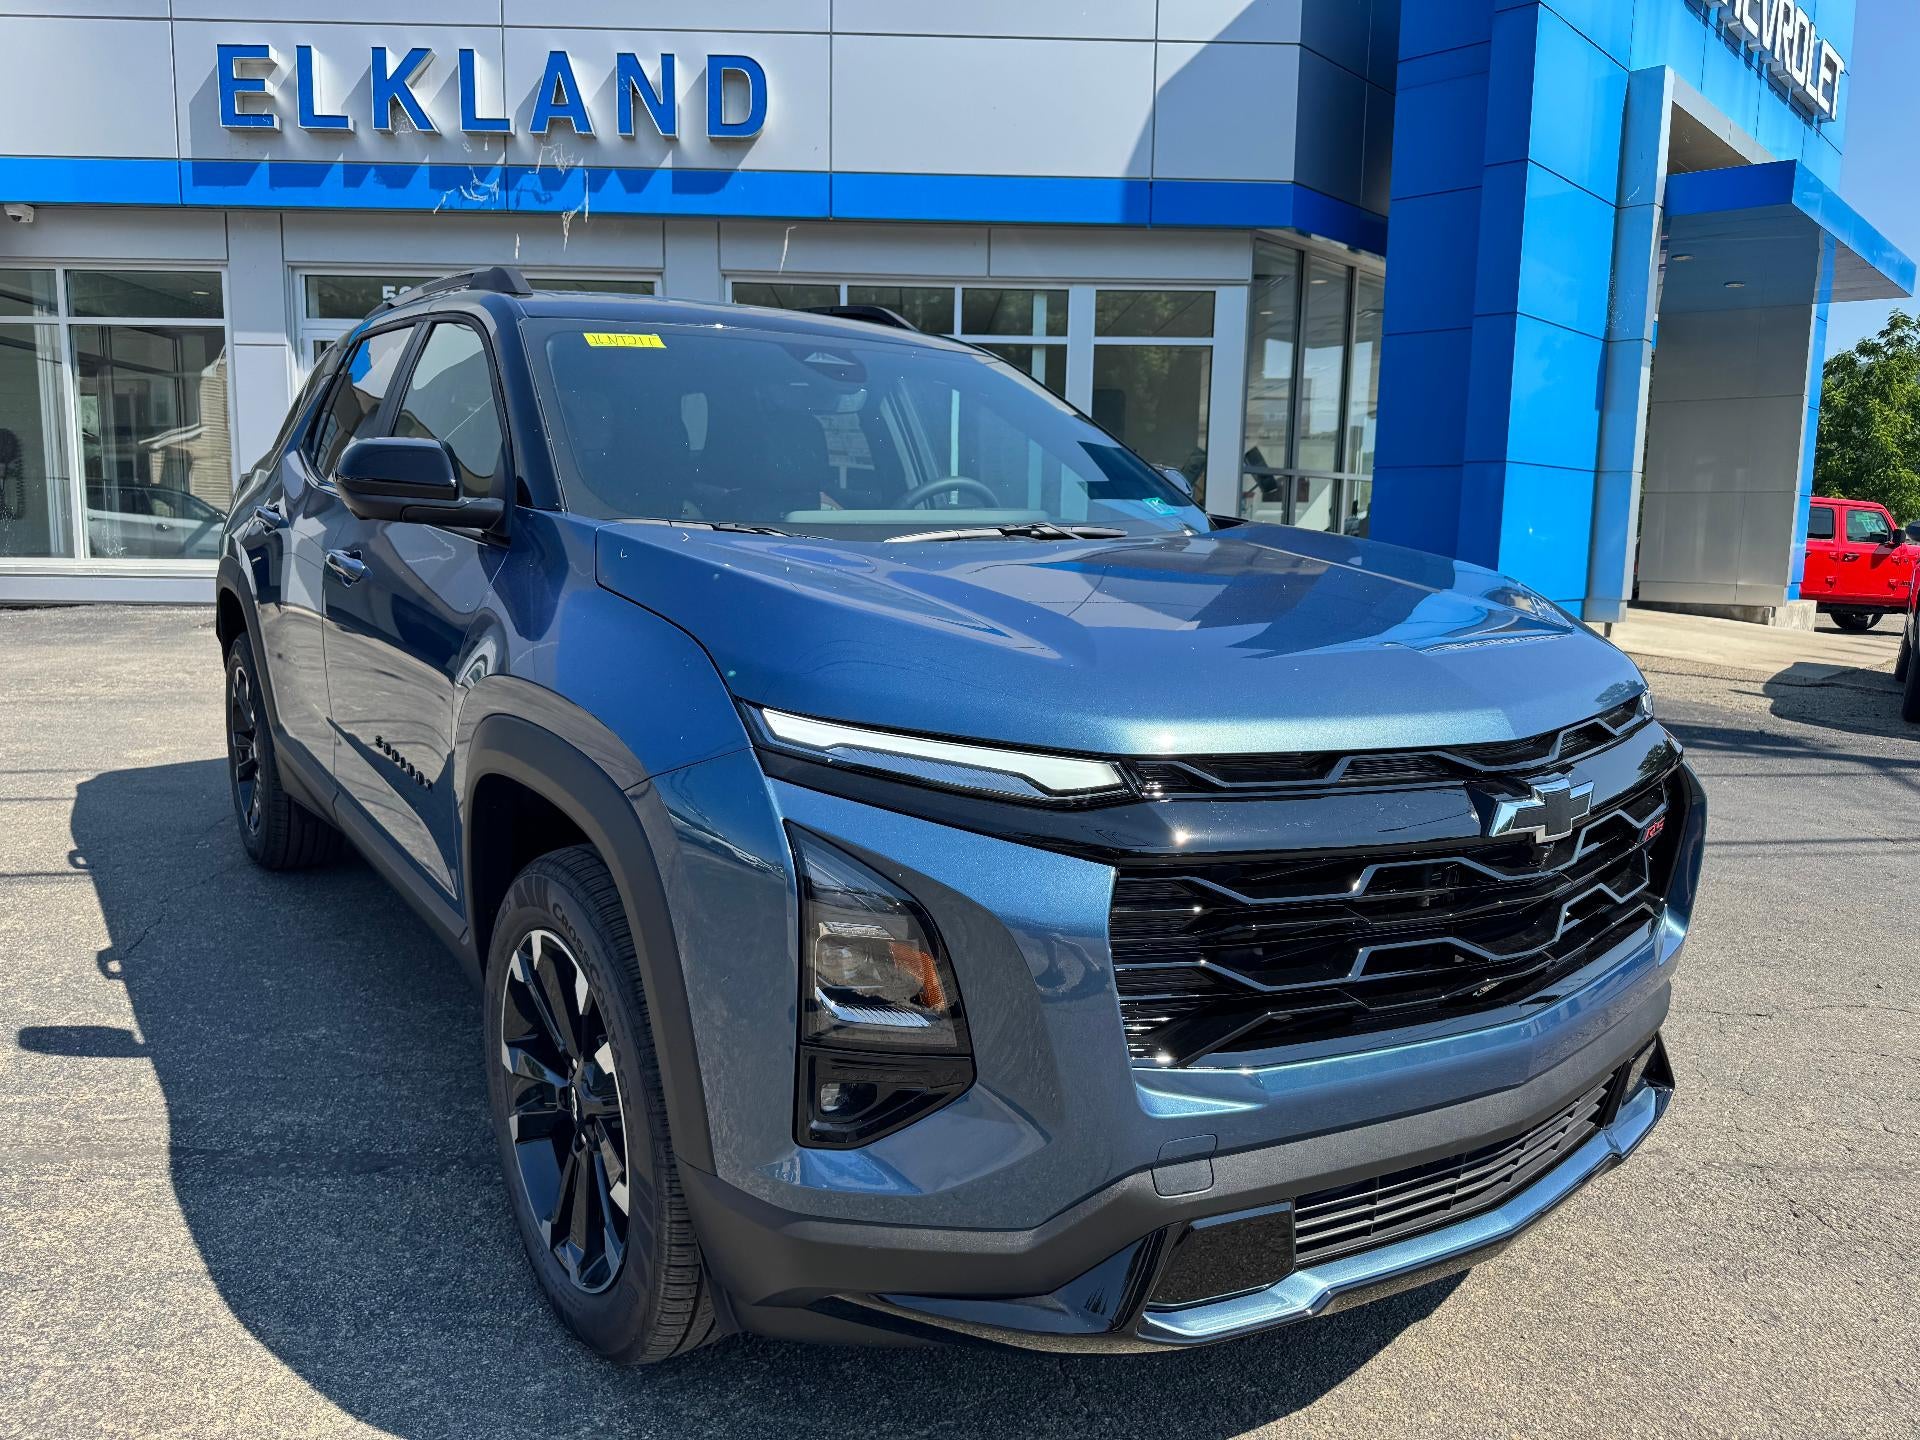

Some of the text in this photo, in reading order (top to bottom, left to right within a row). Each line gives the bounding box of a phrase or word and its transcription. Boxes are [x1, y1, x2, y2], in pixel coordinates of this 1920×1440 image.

[216, 43, 768, 138] ELKLAND
[1719, 0, 1845, 121] VROLET
[1644, 816, 1665, 841] RS
